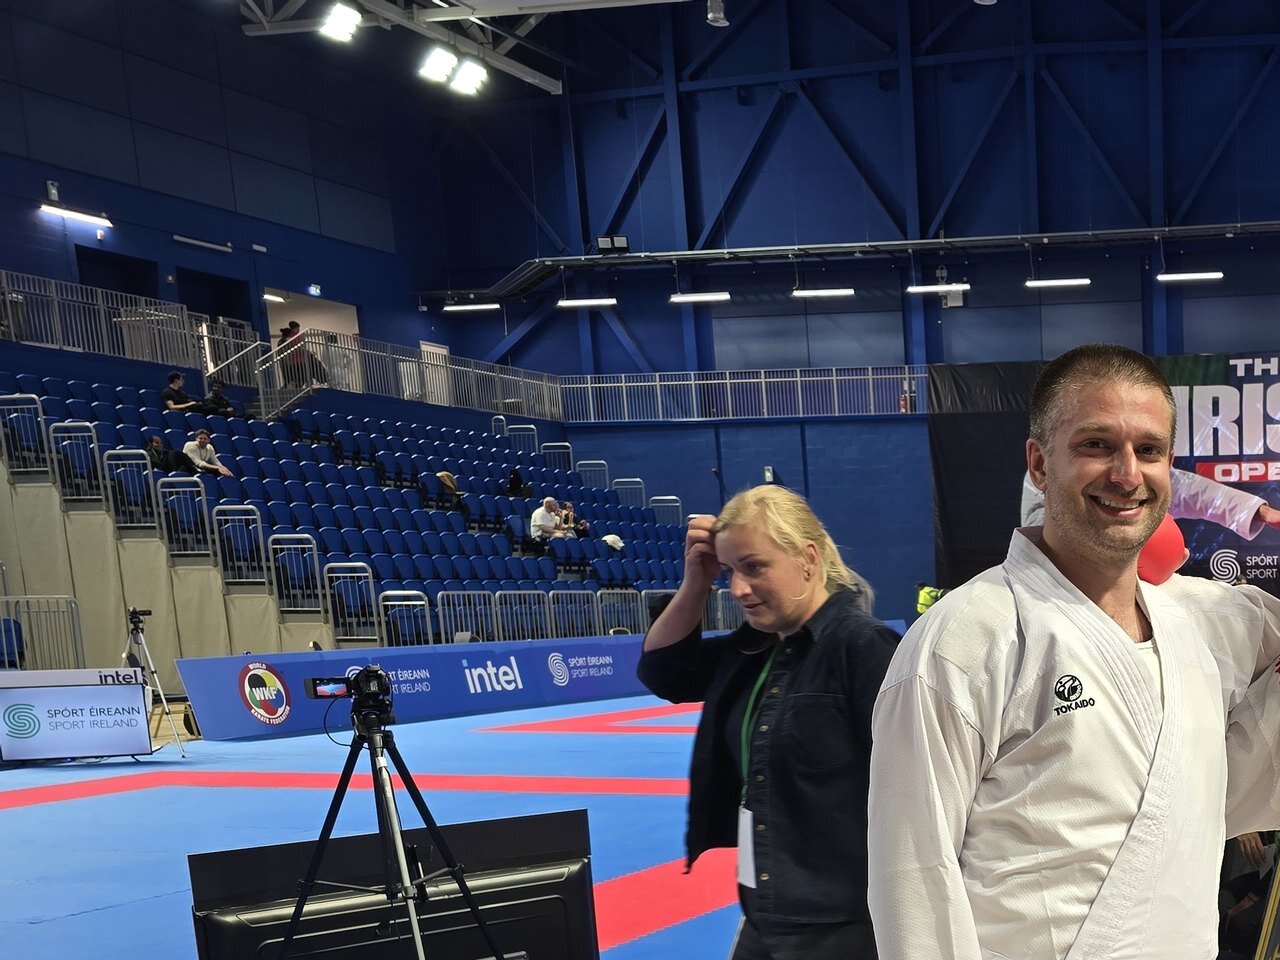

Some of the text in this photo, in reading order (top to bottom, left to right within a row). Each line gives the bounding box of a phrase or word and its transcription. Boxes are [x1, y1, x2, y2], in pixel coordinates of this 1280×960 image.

[1246, 553, 1279, 566] SPÓRT
[1246, 568, 1278, 579] SPORT
[98, 670, 138, 684] intel
[397, 668, 430, 681] ÉIREANN
[461, 656, 523, 694] intel
[570, 666, 614, 679] SPORT IRELAND
[252, 686, 277, 701] WKF
[400, 682, 431, 694] IRELAND
[47, 705, 141, 719] SPÓRT ÉIREANN
[1053, 697, 1095, 716] TOKAIDO
[250, 708, 270, 724] KARATE
[48, 718, 139, 731] SPORT IRELAND
